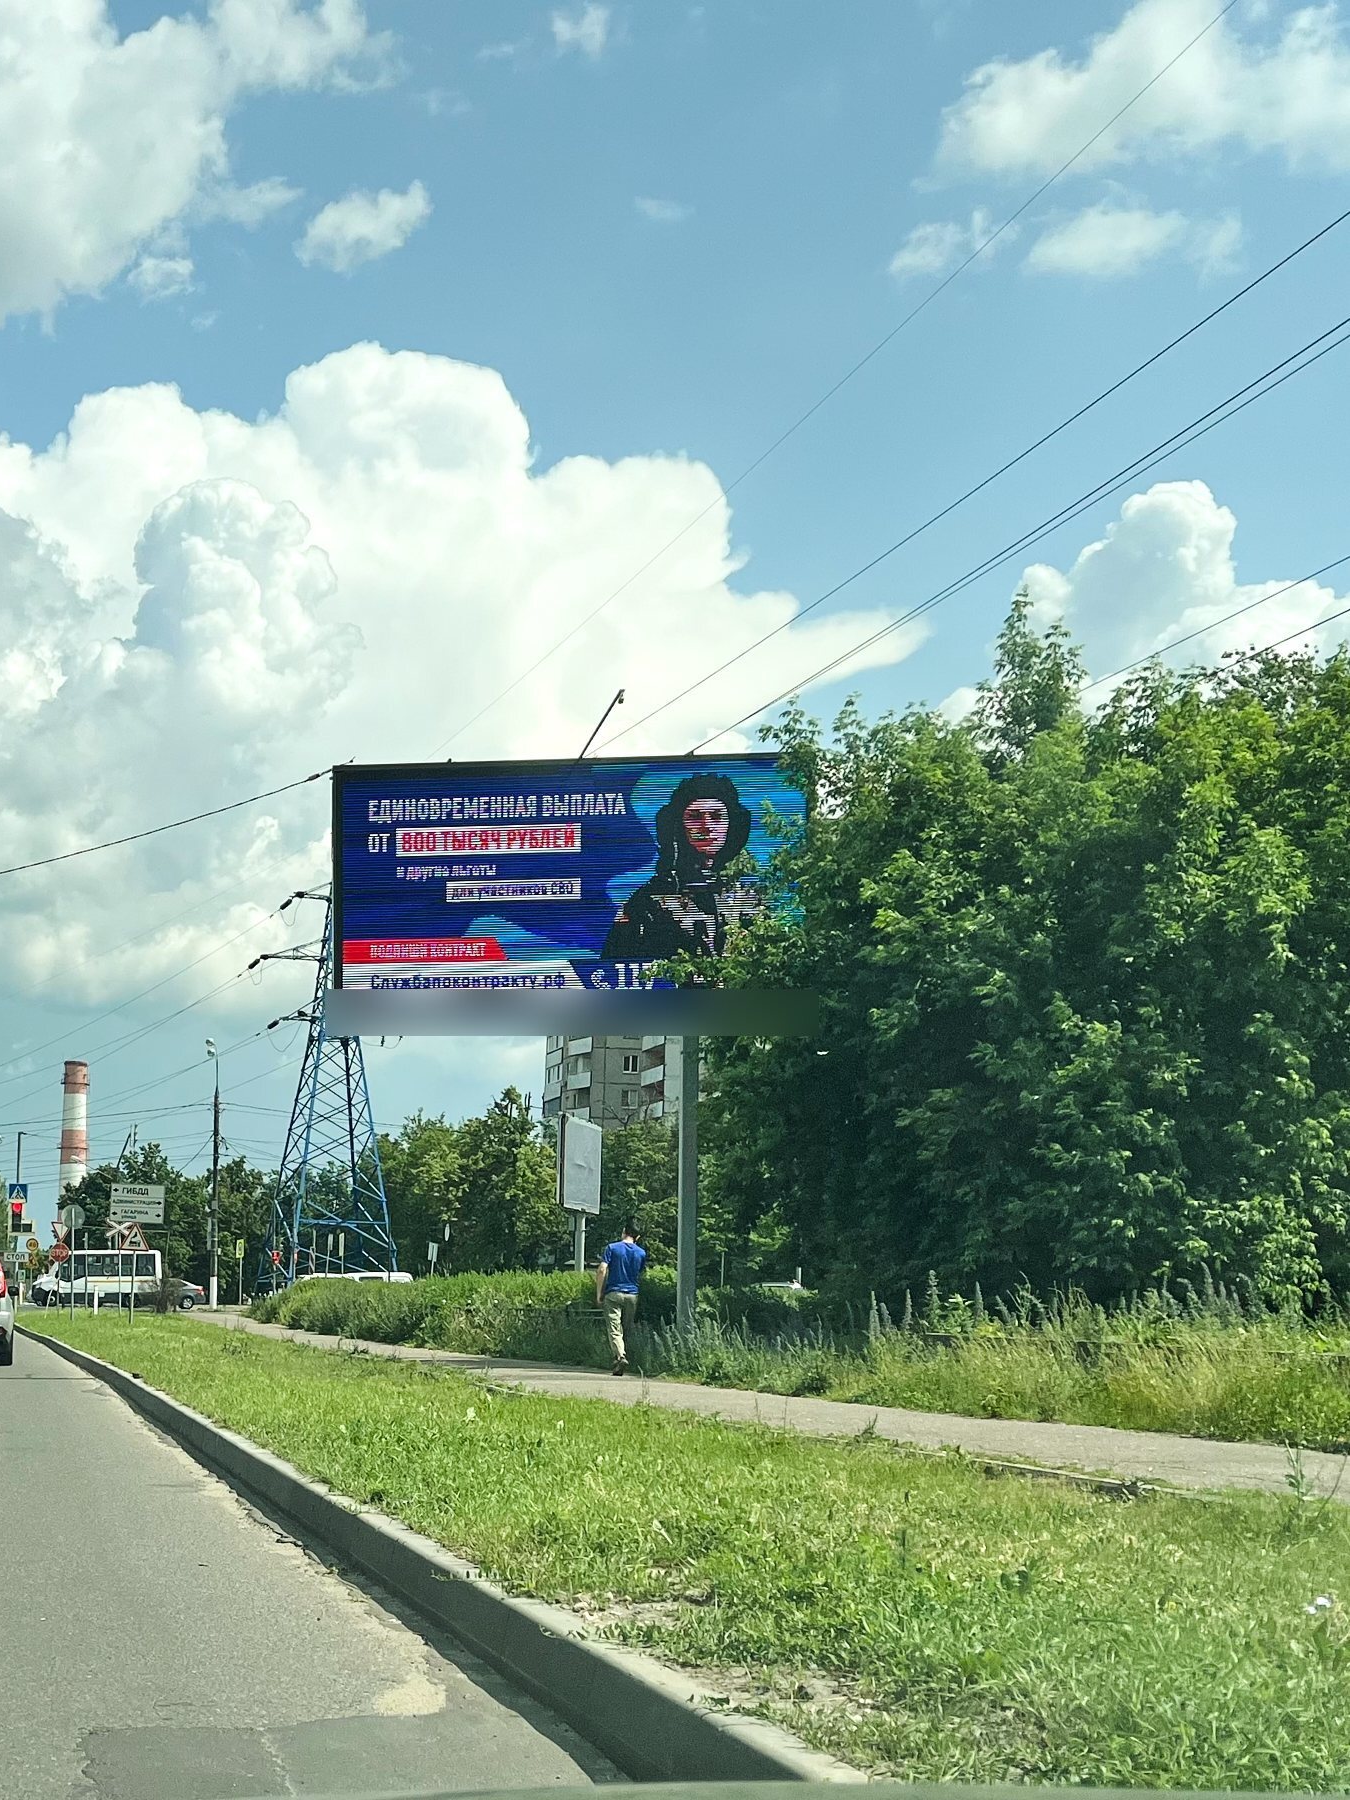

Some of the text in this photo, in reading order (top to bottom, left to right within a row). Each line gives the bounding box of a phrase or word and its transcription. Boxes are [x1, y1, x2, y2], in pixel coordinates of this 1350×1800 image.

[368, 793, 626, 823] ЕДИНОВРЕМЕННАЯ ВЫПЛАТА
[368, 822, 575, 853] ОТ 800 ТЫСЯЧ РУБЛЕЙ
[550, 881, 574, 895] СВО
[370, 942, 487, 959] ПОДПИШИ КОНТРАКТ
[122, 1187, 149, 1196] ГИБДД
[6, 1253, 25, 1261] СТОП
[51, 1249, 68, 1257] STOP
